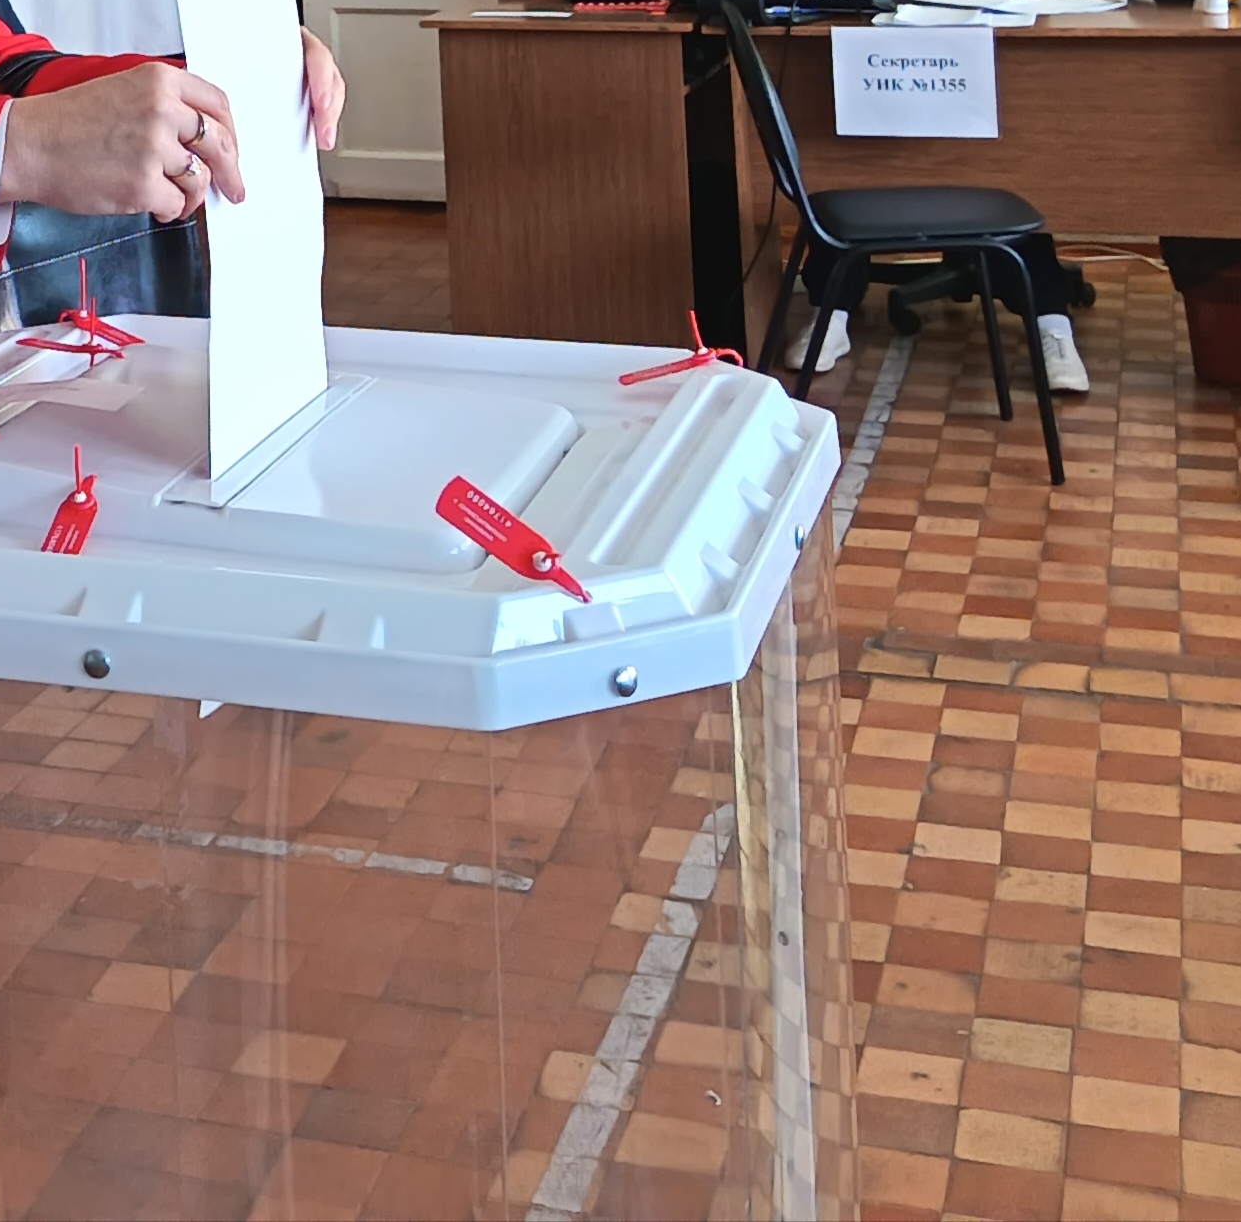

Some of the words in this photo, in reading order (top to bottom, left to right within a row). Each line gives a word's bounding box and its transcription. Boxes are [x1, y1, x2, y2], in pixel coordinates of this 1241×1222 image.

[867, 53, 959, 71] Секретарь
[863, 78, 904, 91] УИК
[908, 78, 967, 92] №1355
